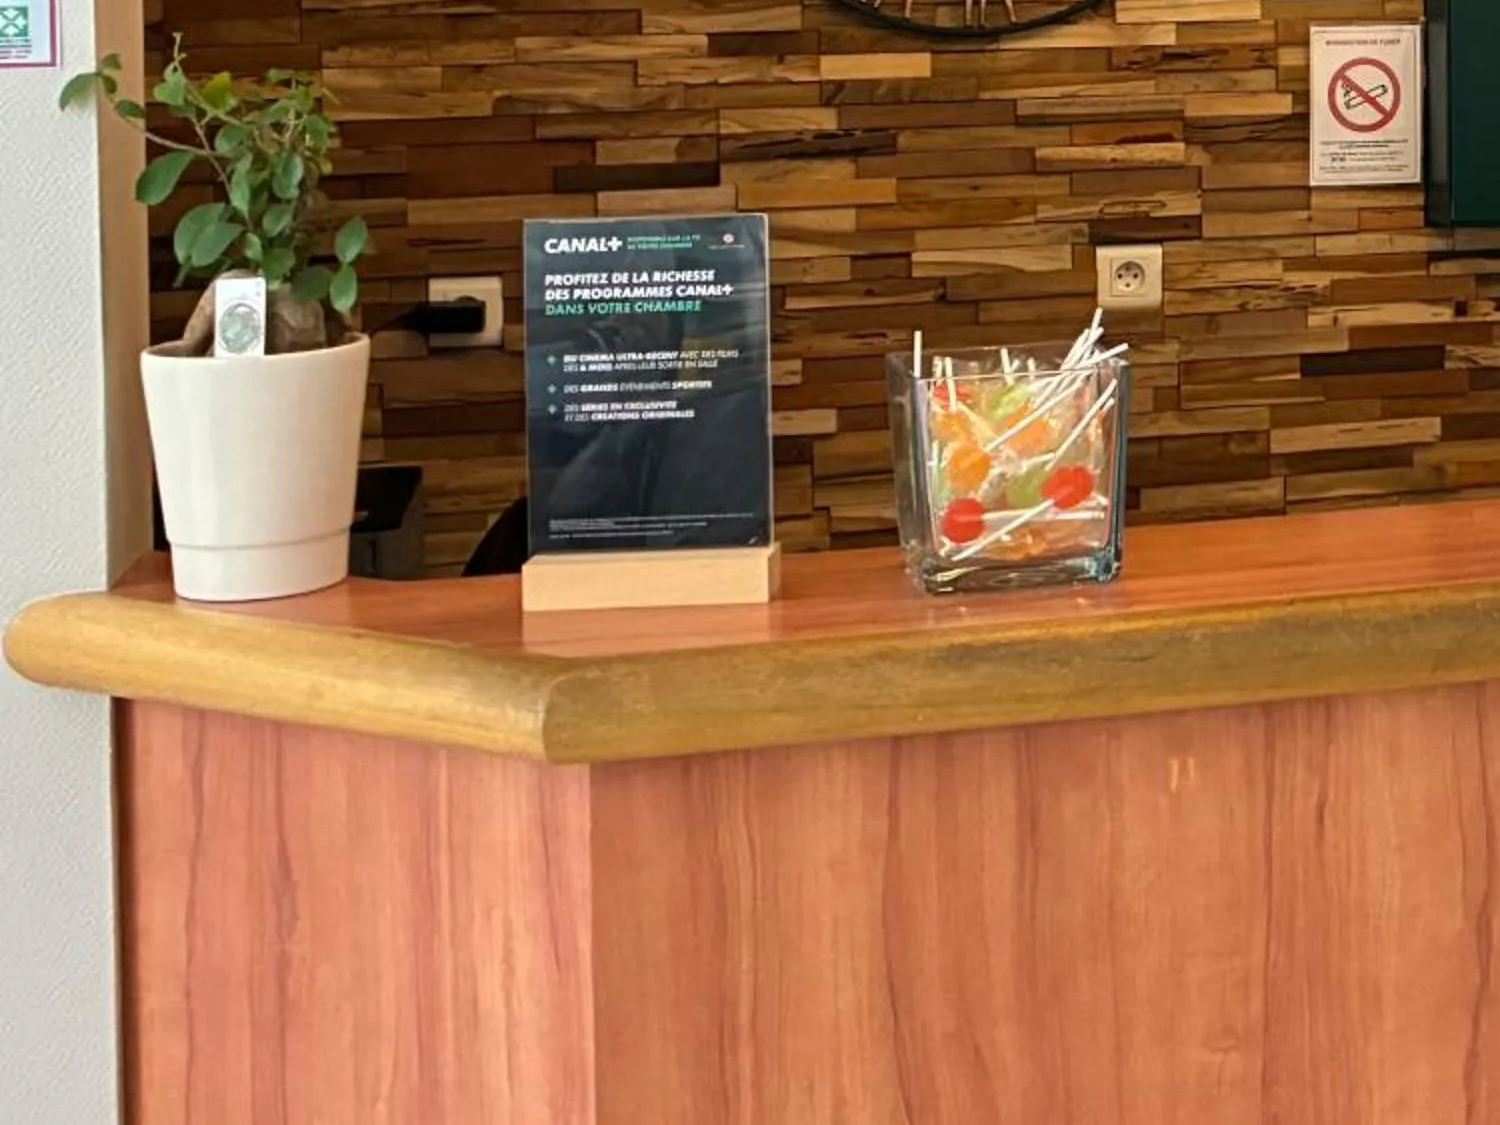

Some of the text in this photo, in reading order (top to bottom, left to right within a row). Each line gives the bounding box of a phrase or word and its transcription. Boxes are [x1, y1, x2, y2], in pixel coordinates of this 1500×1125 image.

[544, 235, 622, 254] CANAL+
[545, 269, 716, 287] PROFITEZ DE LA RICHESSE
[545, 283, 734, 301] DES PROGRAMMES CANAL+
[545, 300, 703, 316] DANS VOTRE CHAMBRE
